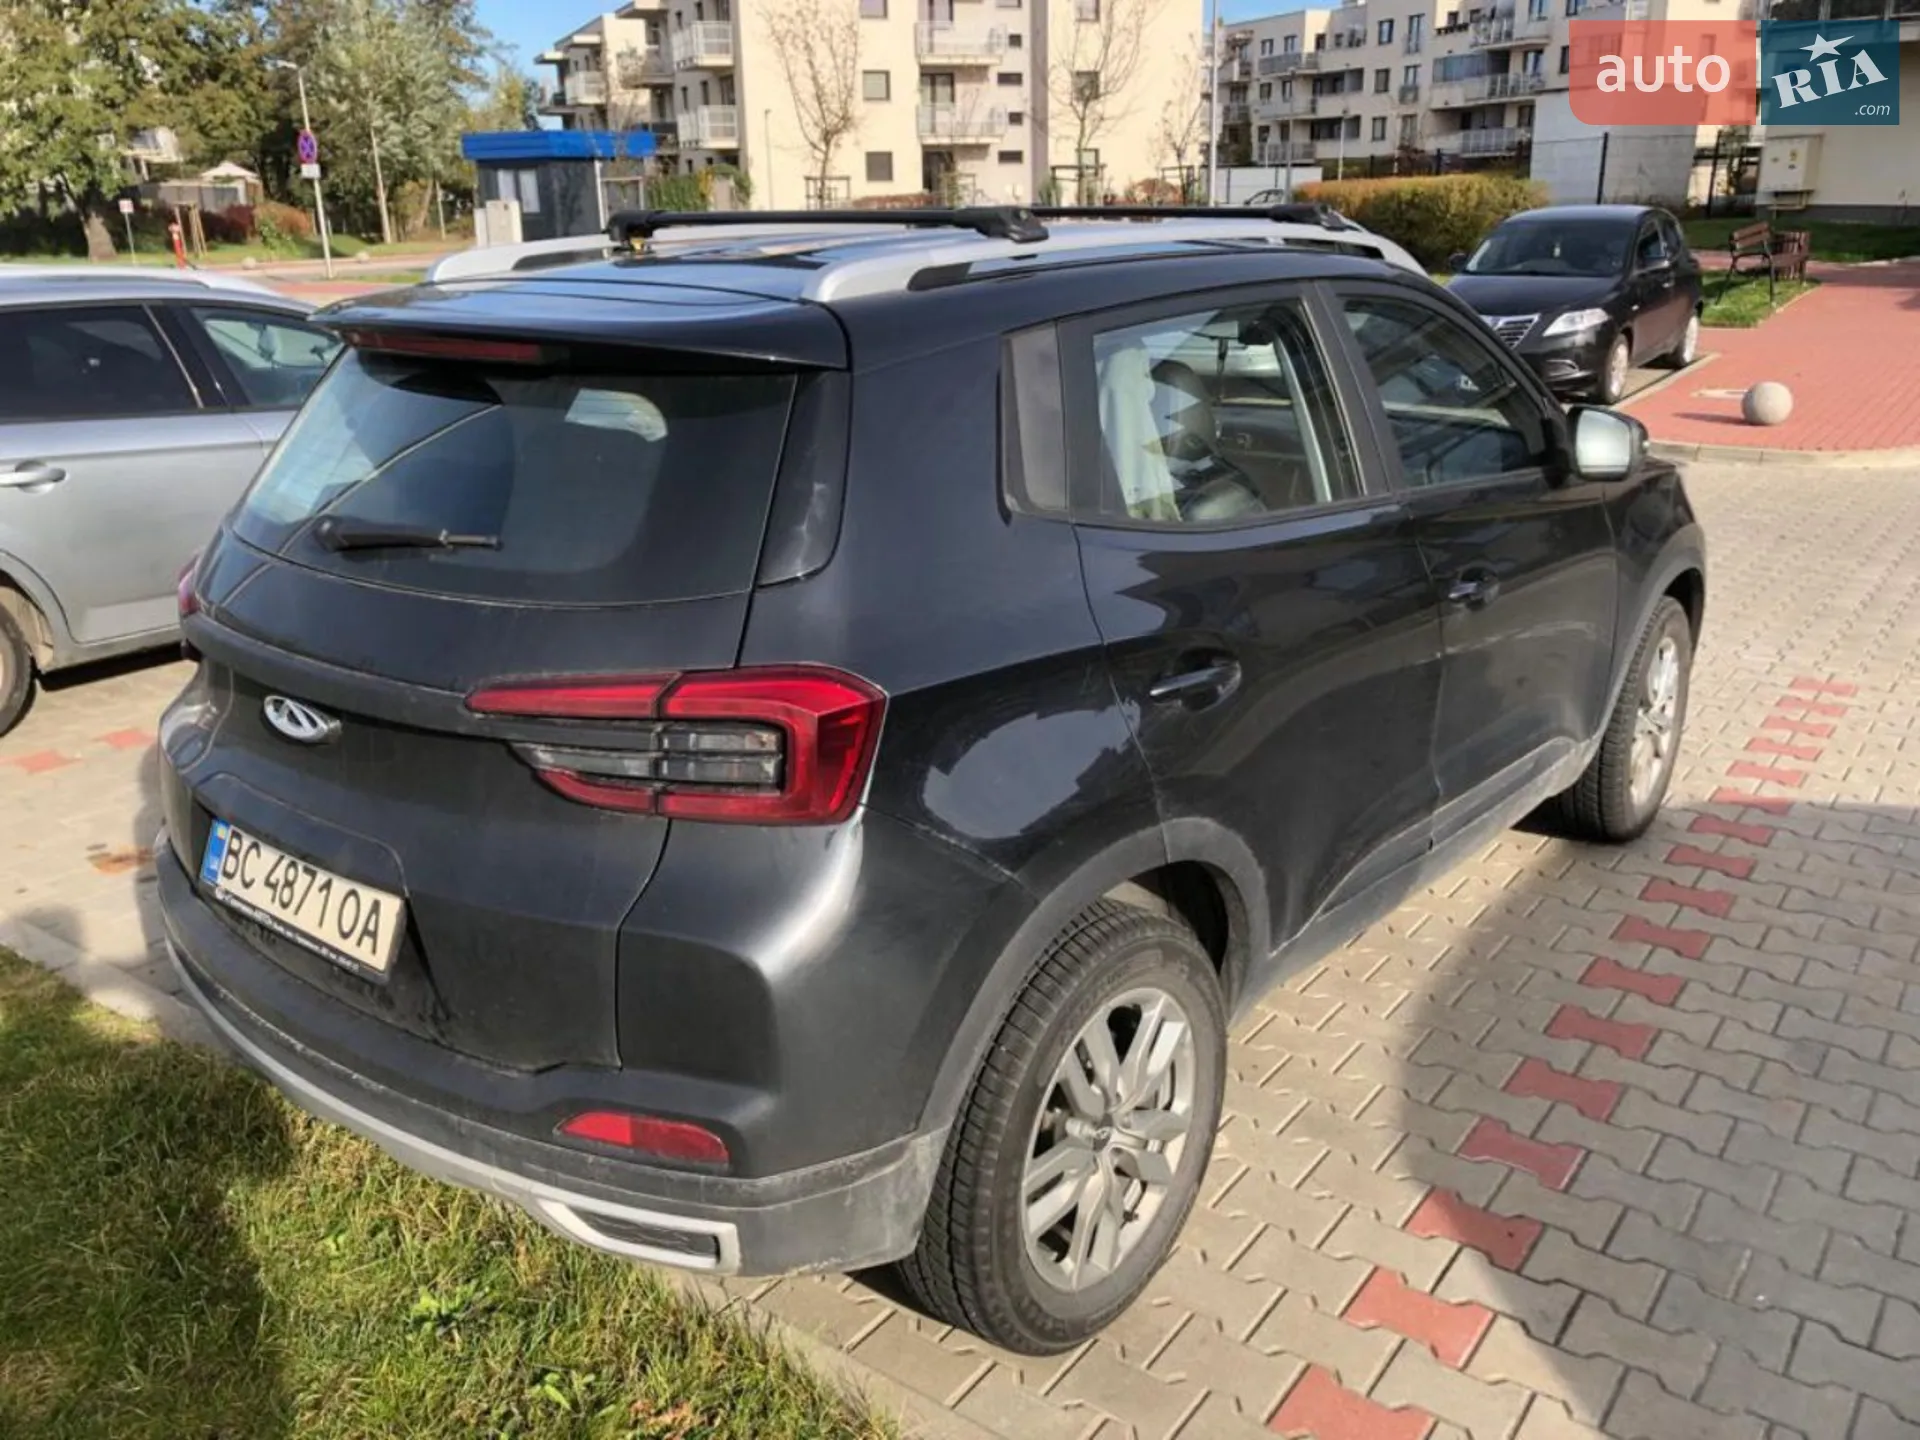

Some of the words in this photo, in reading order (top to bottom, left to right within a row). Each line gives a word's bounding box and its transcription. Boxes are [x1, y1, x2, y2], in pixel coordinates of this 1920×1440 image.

[221, 829, 261, 890] BC
[263, 855, 333, 929] 4871
[337, 888, 382, 956] OA
